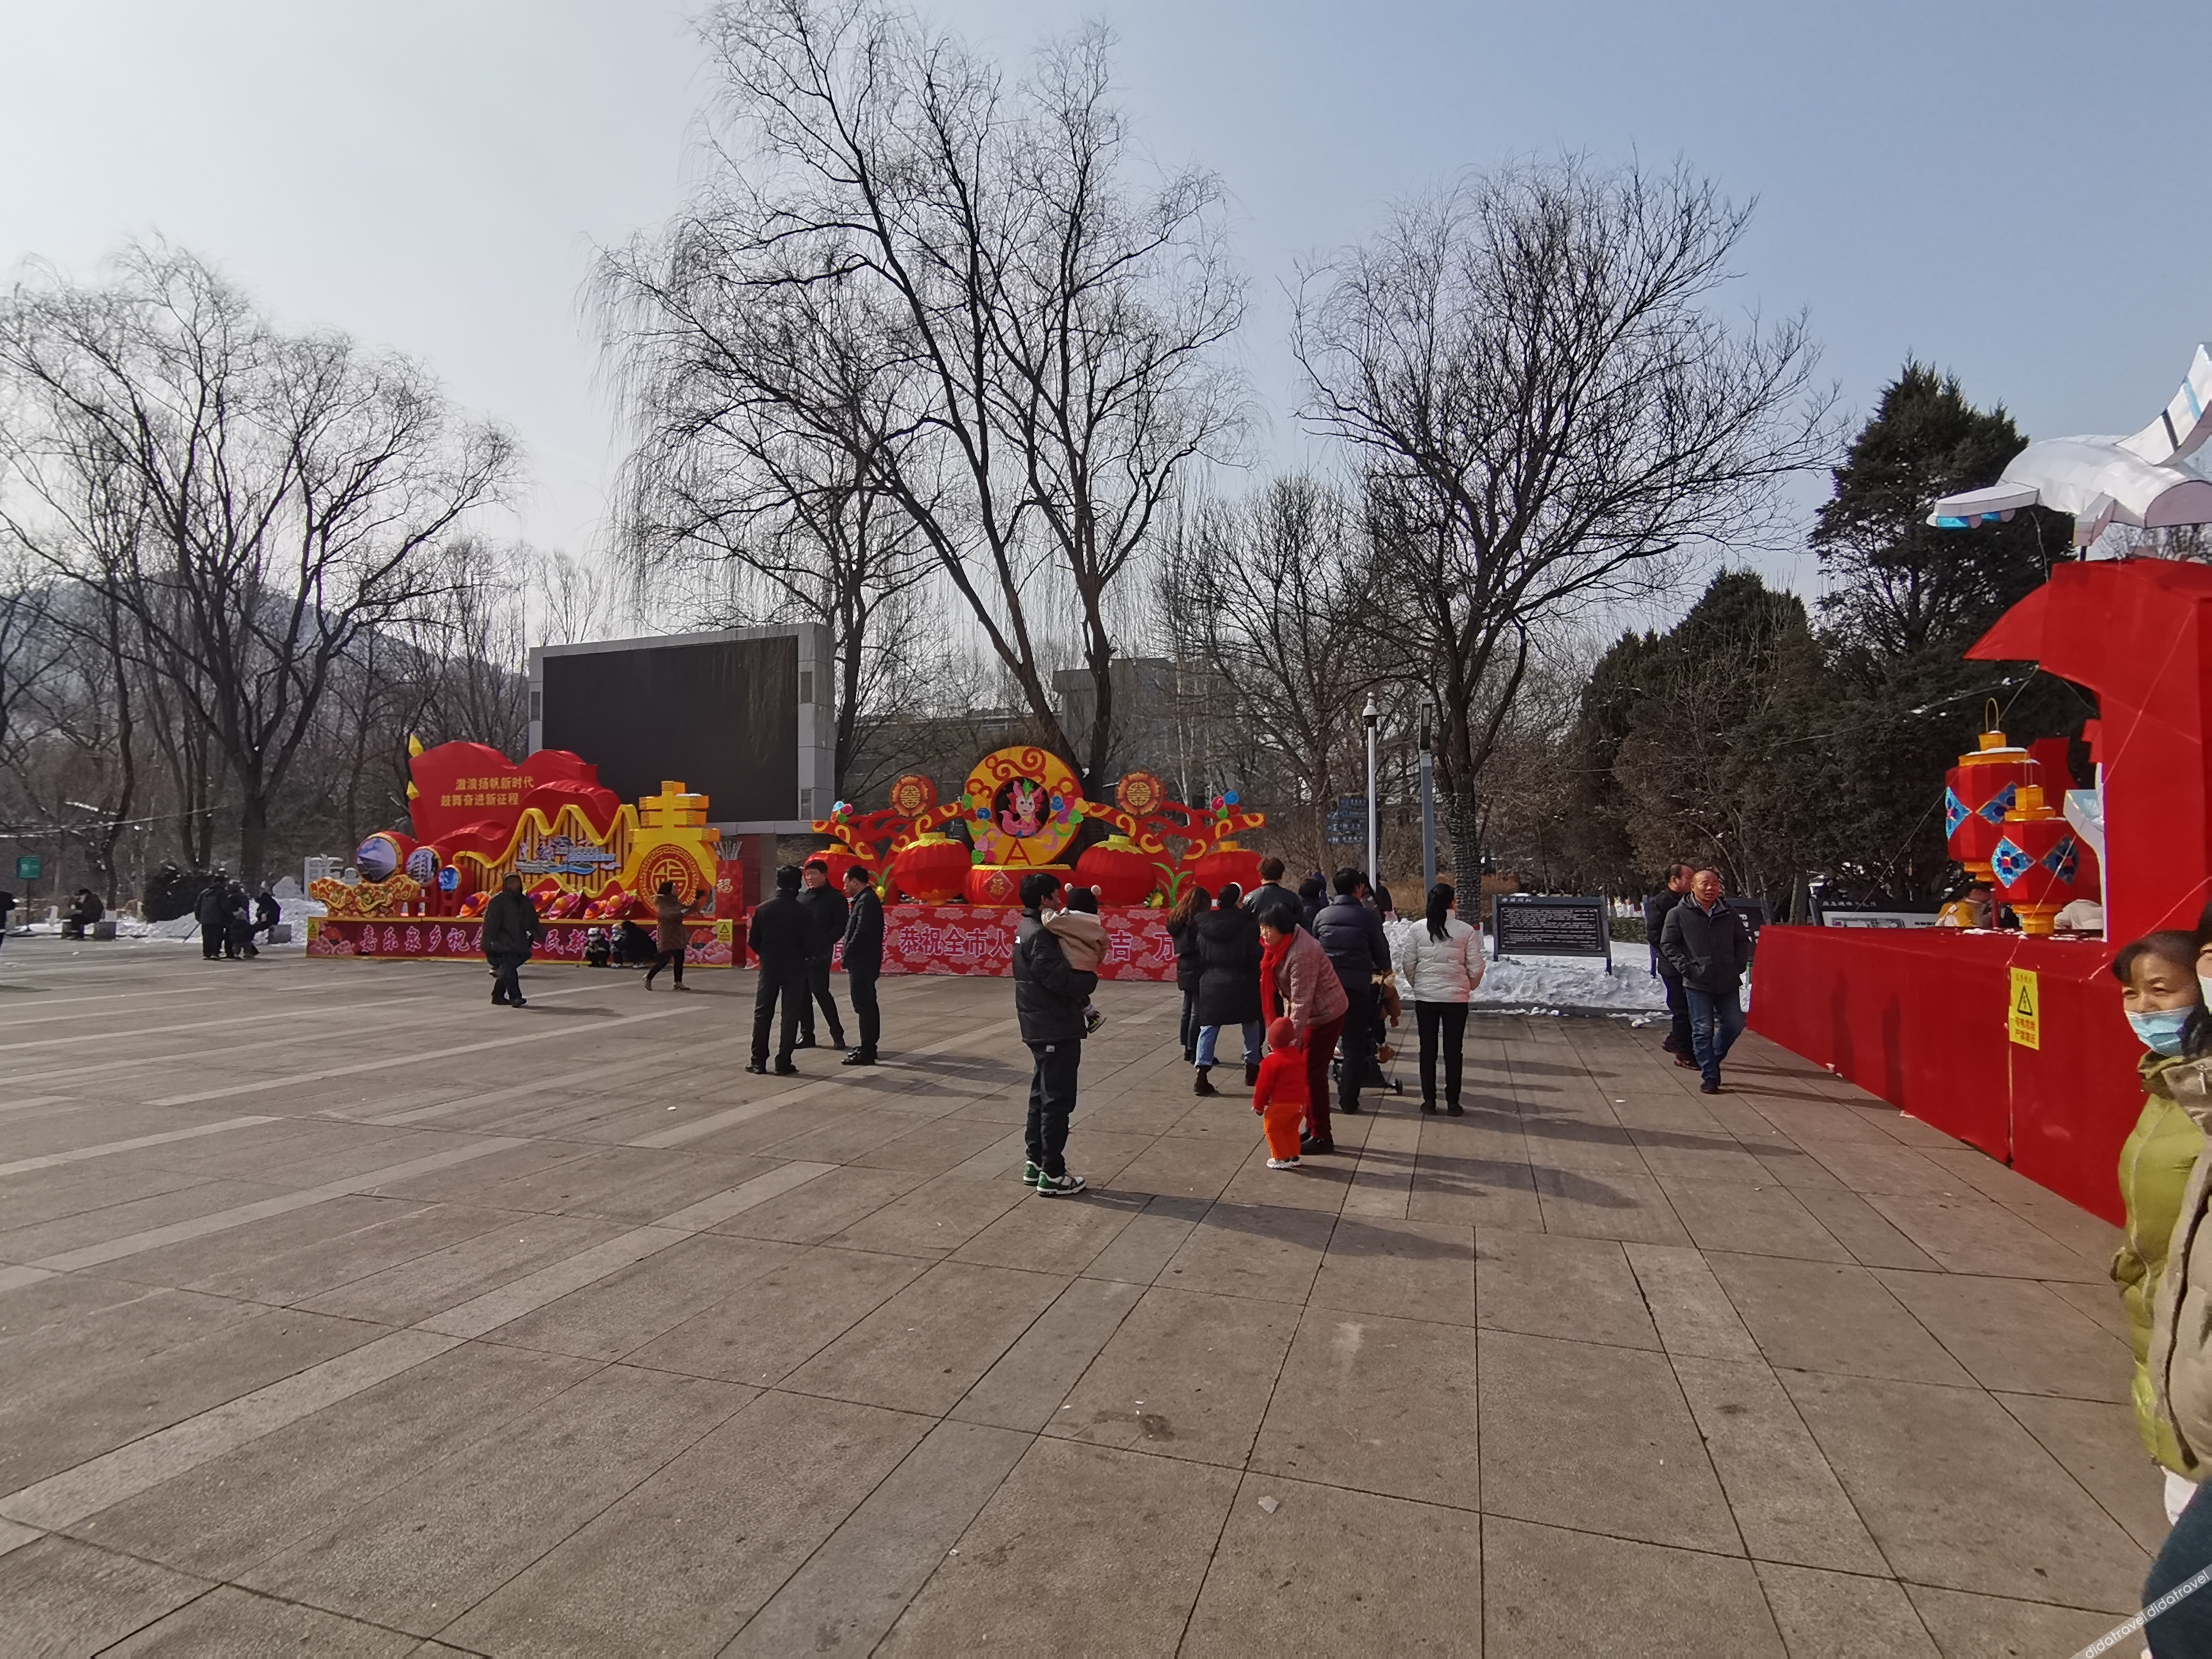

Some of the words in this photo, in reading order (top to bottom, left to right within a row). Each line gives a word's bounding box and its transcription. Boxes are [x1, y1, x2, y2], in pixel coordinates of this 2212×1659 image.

[441, 792, 519, 807] 鼓舞奋进新征程
